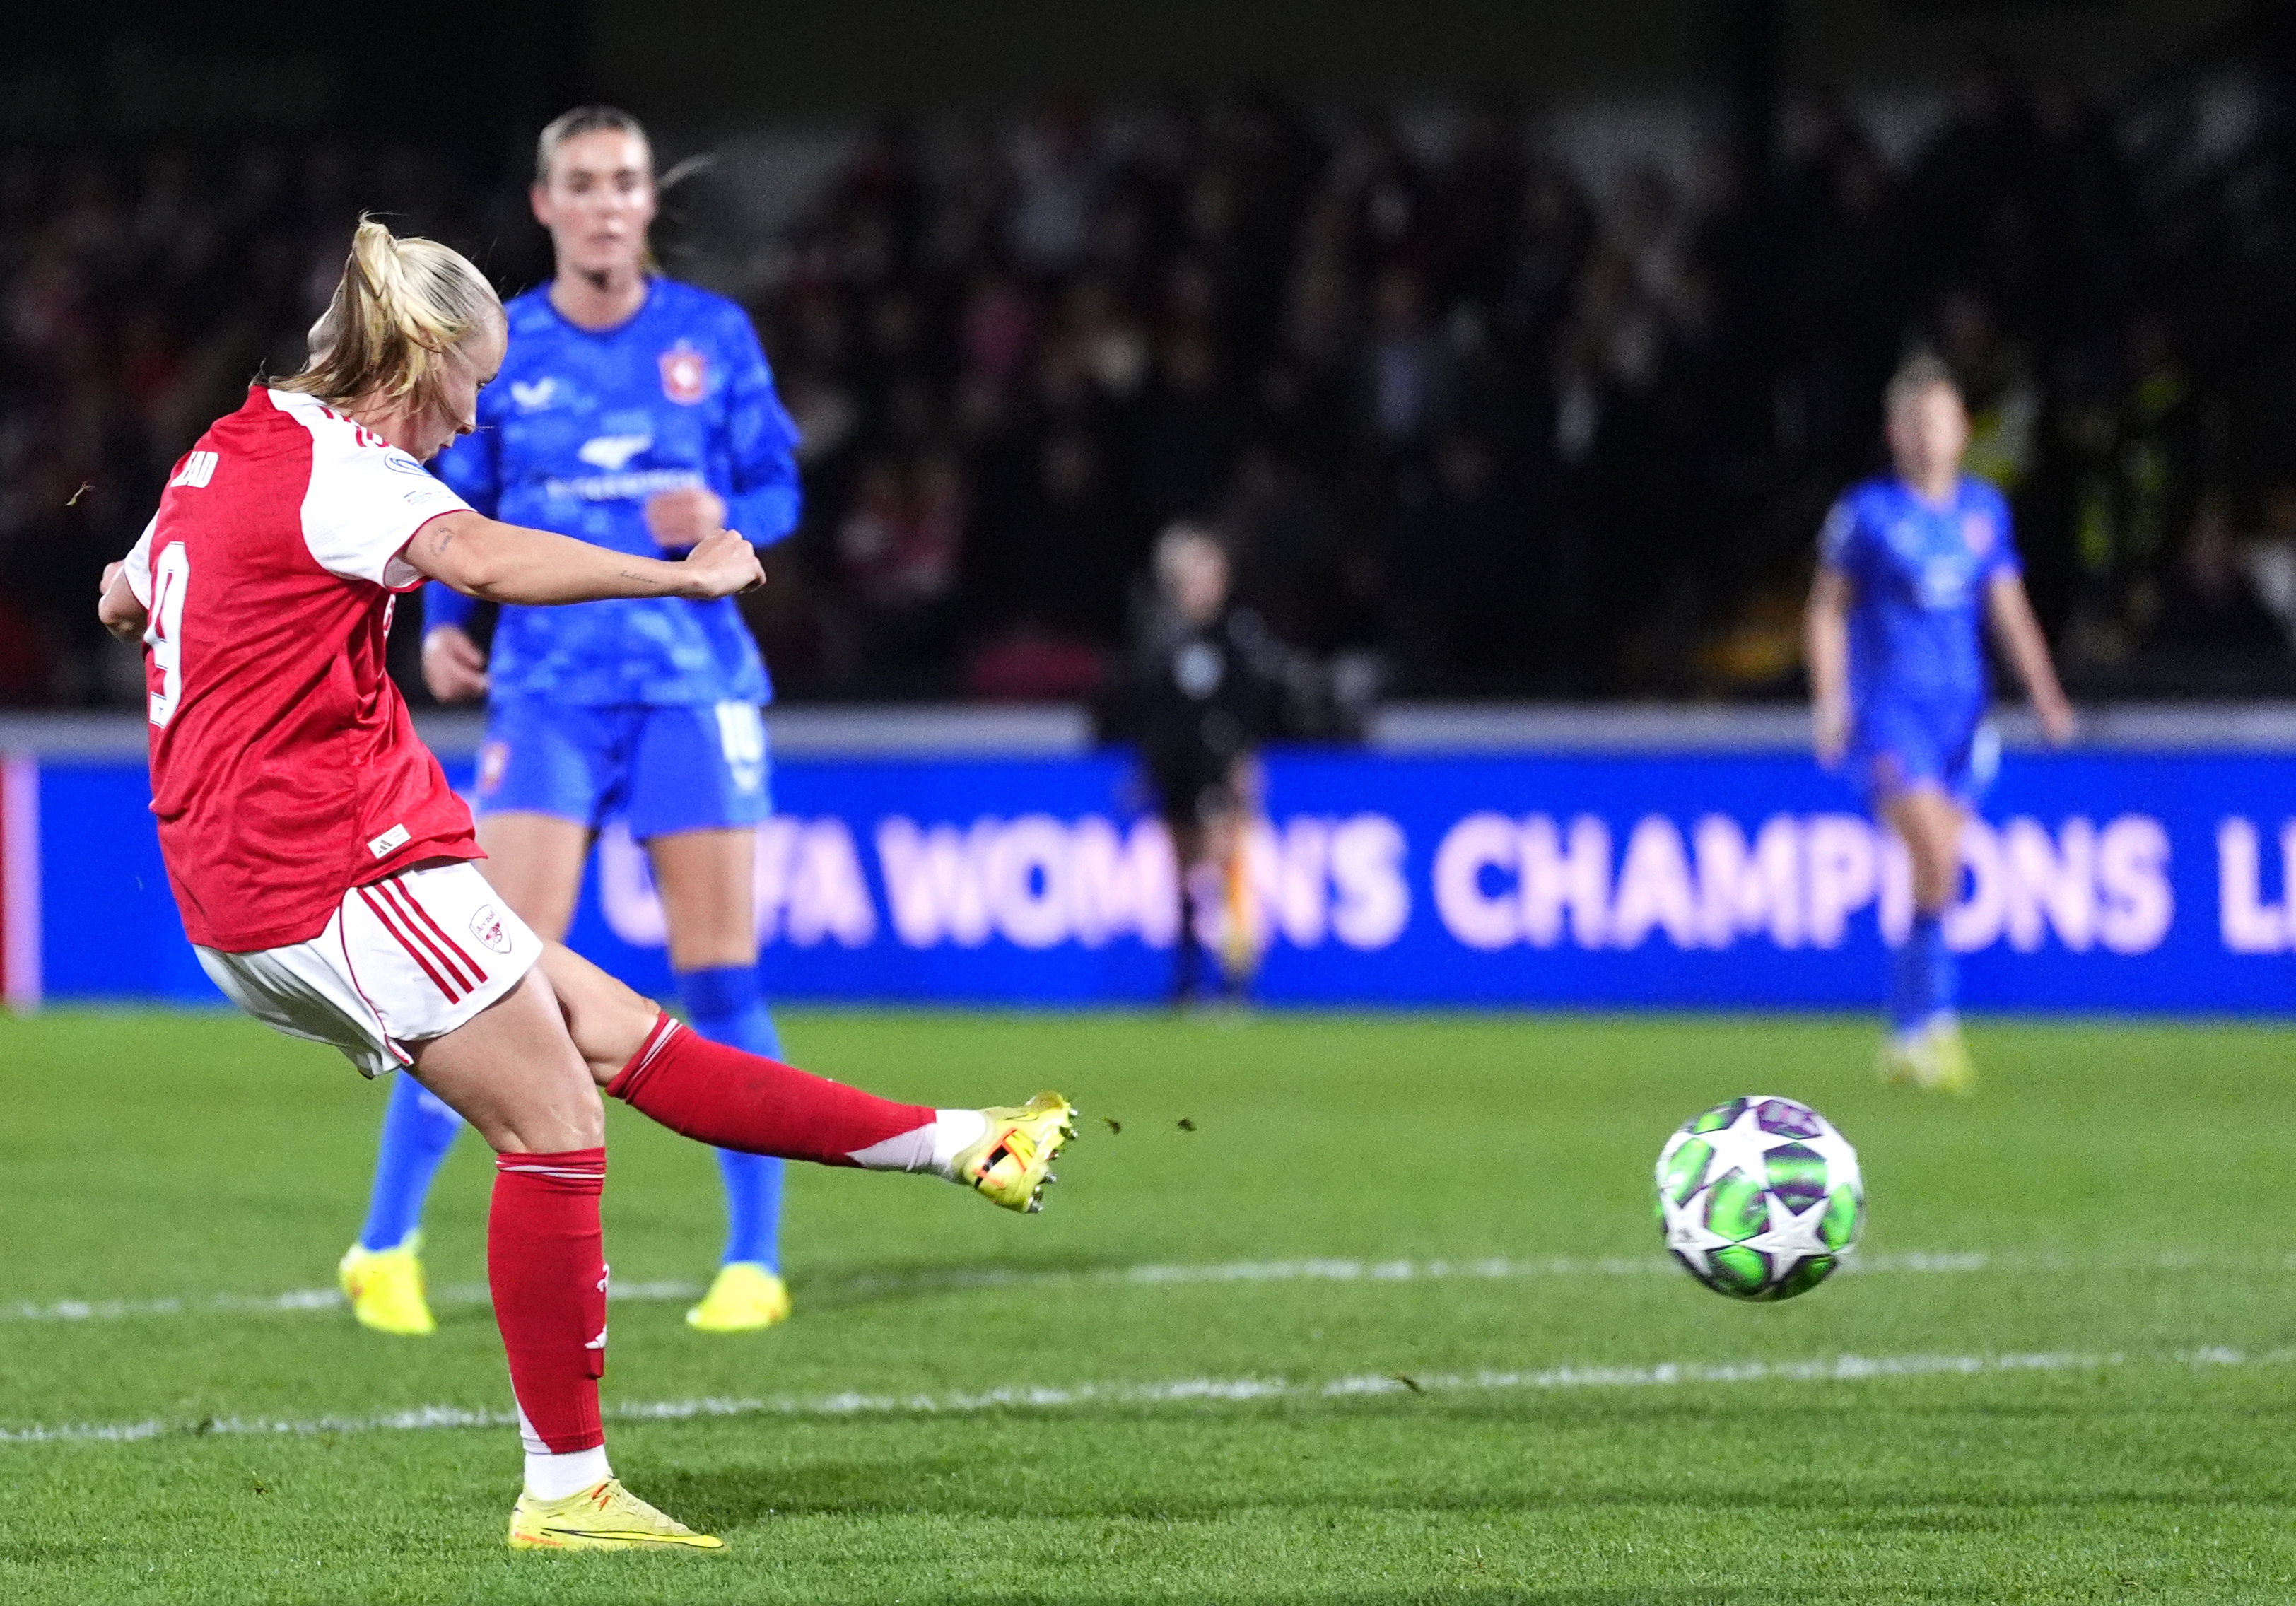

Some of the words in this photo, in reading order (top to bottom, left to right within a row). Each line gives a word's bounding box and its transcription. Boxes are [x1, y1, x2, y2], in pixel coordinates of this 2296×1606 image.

[170, 450, 219, 488] EAD
[144, 541, 191, 729] 9
[598, 816, 878, 949] UFA
[1432, 814, 2173, 951] CHAMPIONS
[2217, 818, 2296, 951] L
